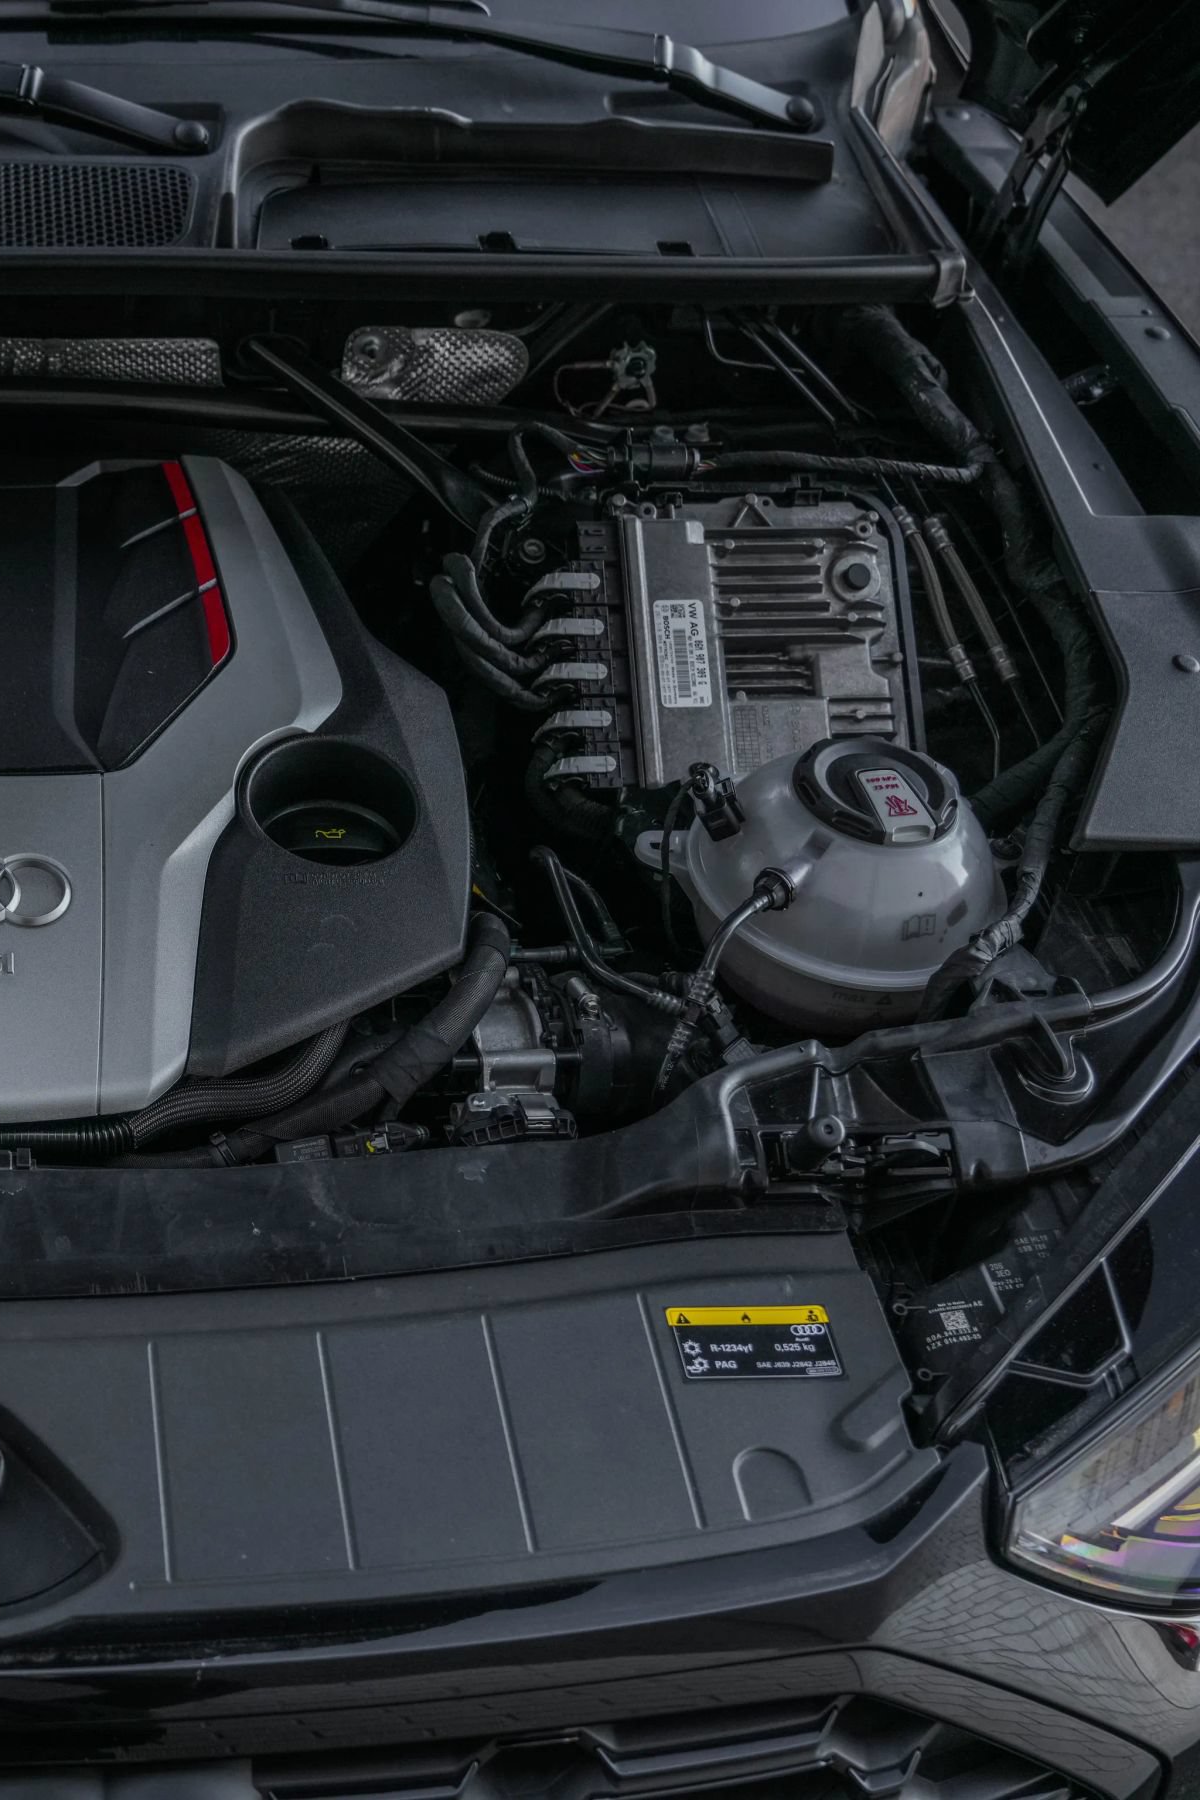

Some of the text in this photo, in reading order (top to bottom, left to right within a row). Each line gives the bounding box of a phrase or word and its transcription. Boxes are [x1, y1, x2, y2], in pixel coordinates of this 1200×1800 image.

[688, 603, 697, 619] VW
[662, 615, 671, 639] BOSCH
[690, 622, 699, 637] AG
[710, 1342, 816, 1354] R-1234yf 0,525 kg
[715, 1360, 738, 1369] PAG
[756, 1361, 772, 1369] SAE
